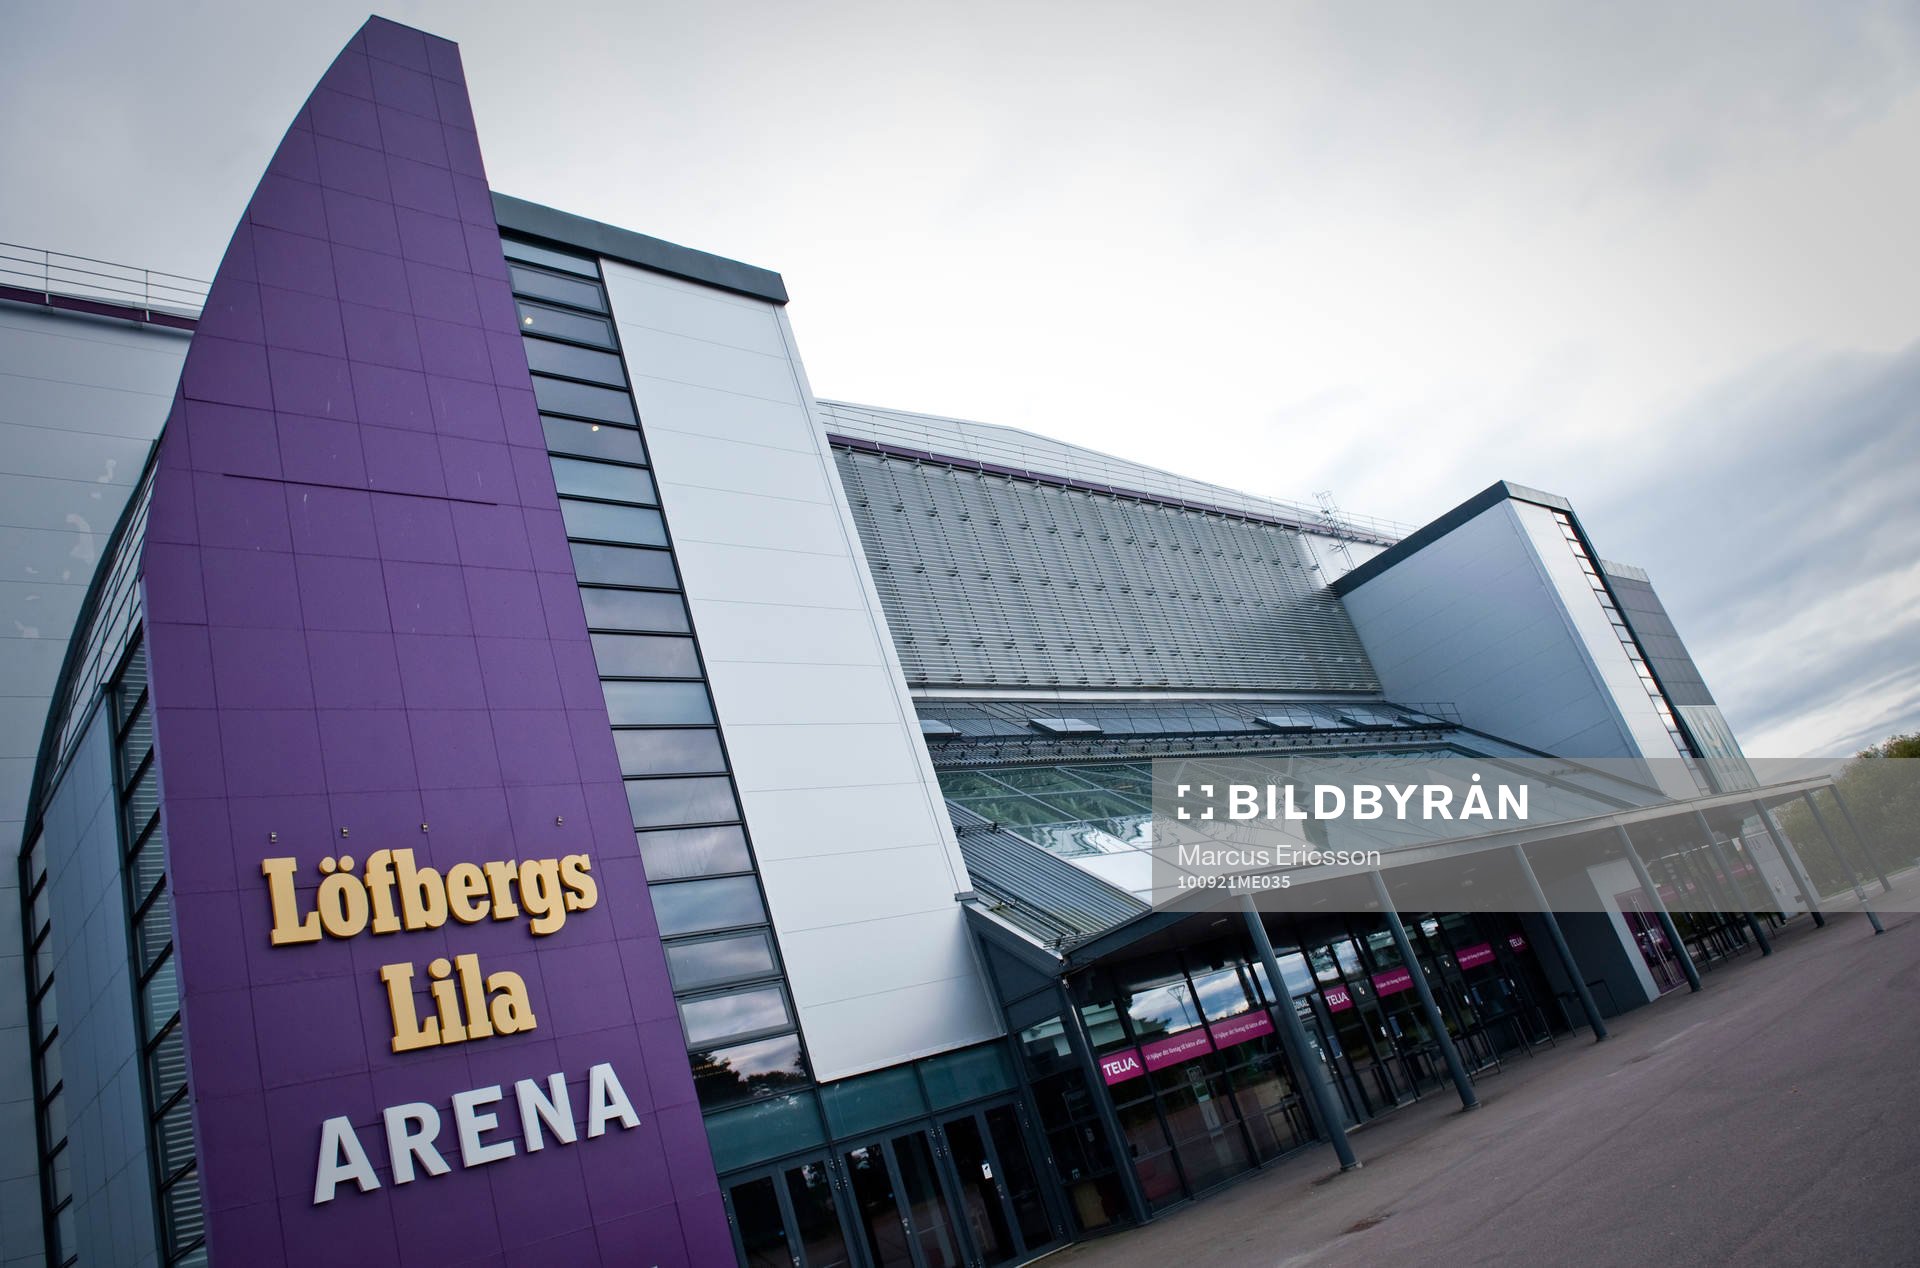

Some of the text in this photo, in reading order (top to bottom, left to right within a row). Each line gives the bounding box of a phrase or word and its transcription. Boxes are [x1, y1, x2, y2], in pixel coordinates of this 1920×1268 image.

[261, 848, 599, 947] Löfbergs
[380, 953, 538, 1053] Lila
[1325, 991, 1350, 1007] TELIA
[1103, 1056, 1140, 1077] TELIA
[313, 1062, 642, 1205] ARENA
